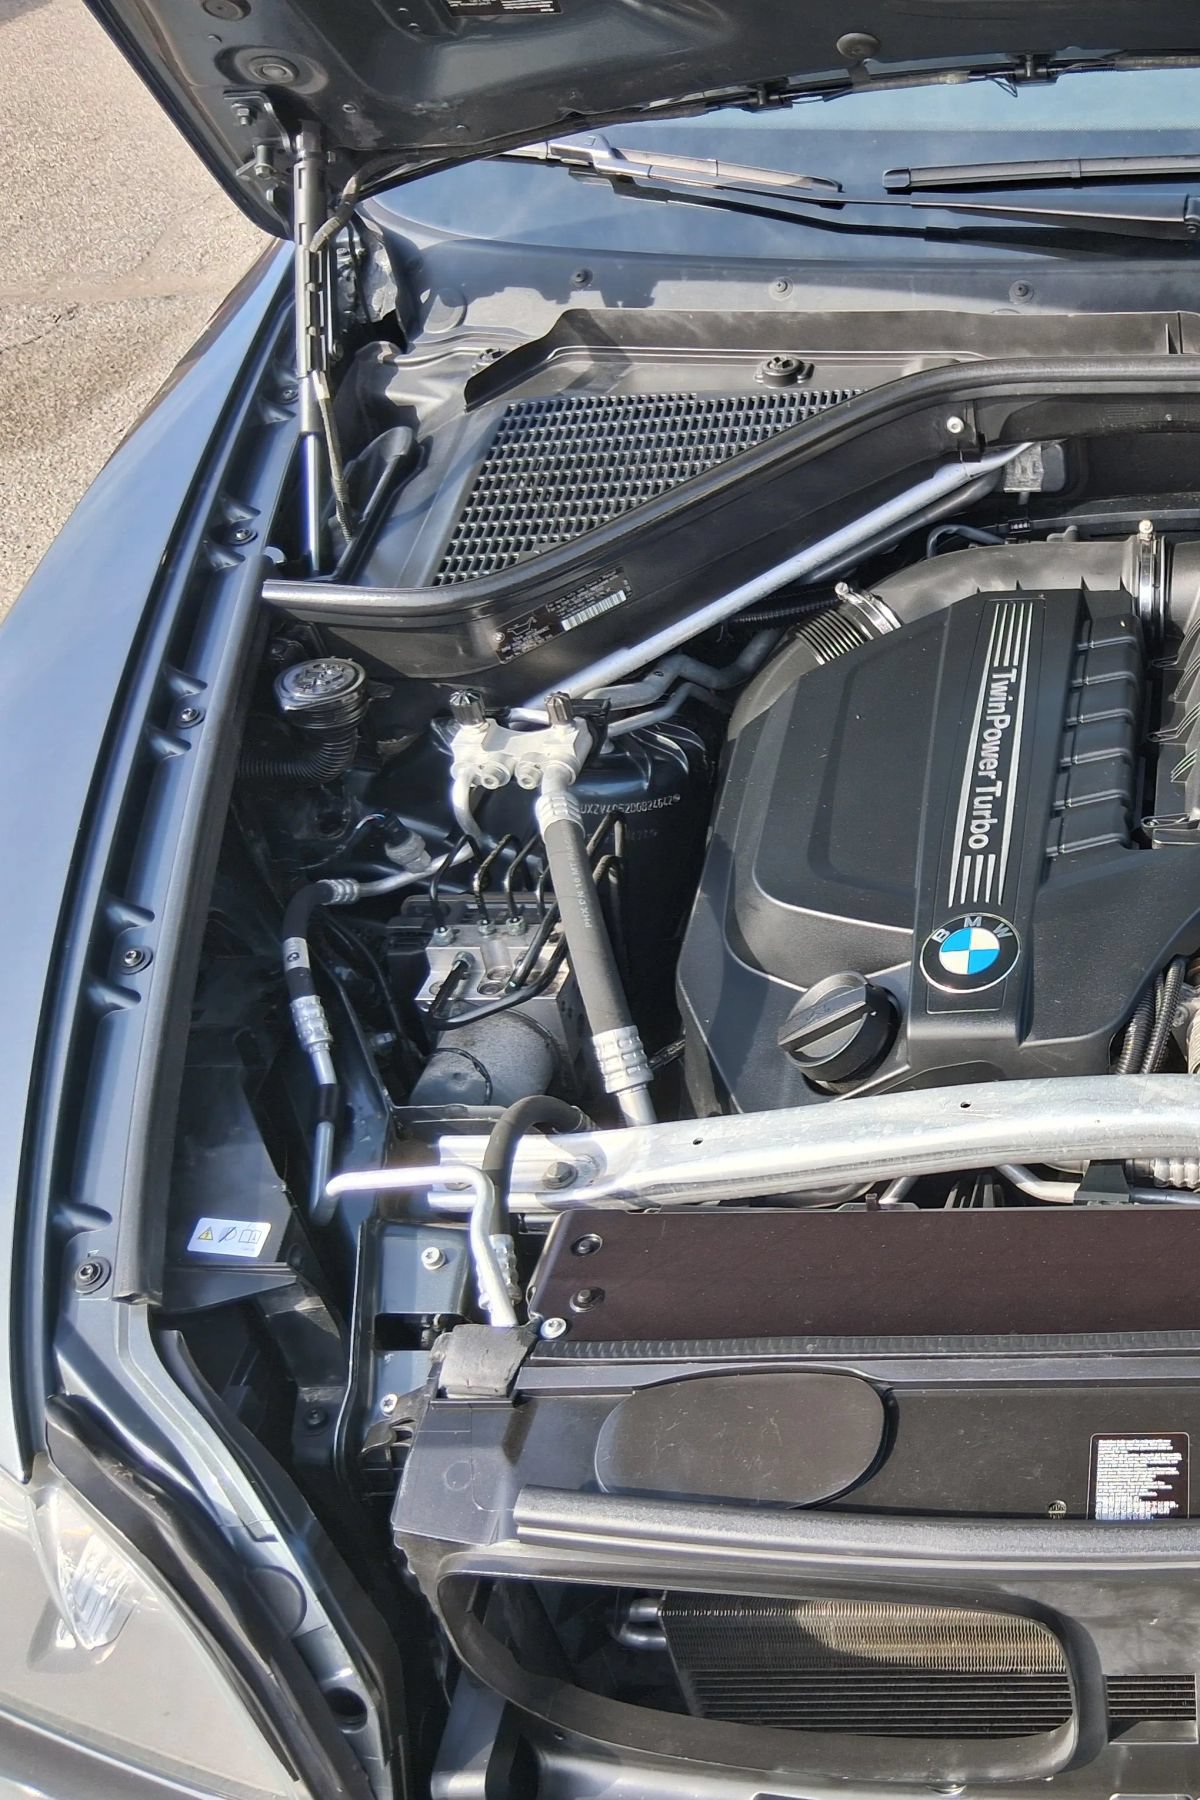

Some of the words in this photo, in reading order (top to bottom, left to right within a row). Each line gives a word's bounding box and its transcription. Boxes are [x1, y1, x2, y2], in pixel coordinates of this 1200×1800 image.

[977, 666, 1017, 778] TwinPower
[968, 780, 1003, 850] Turbo
[931, 916, 1014, 943] BMW
